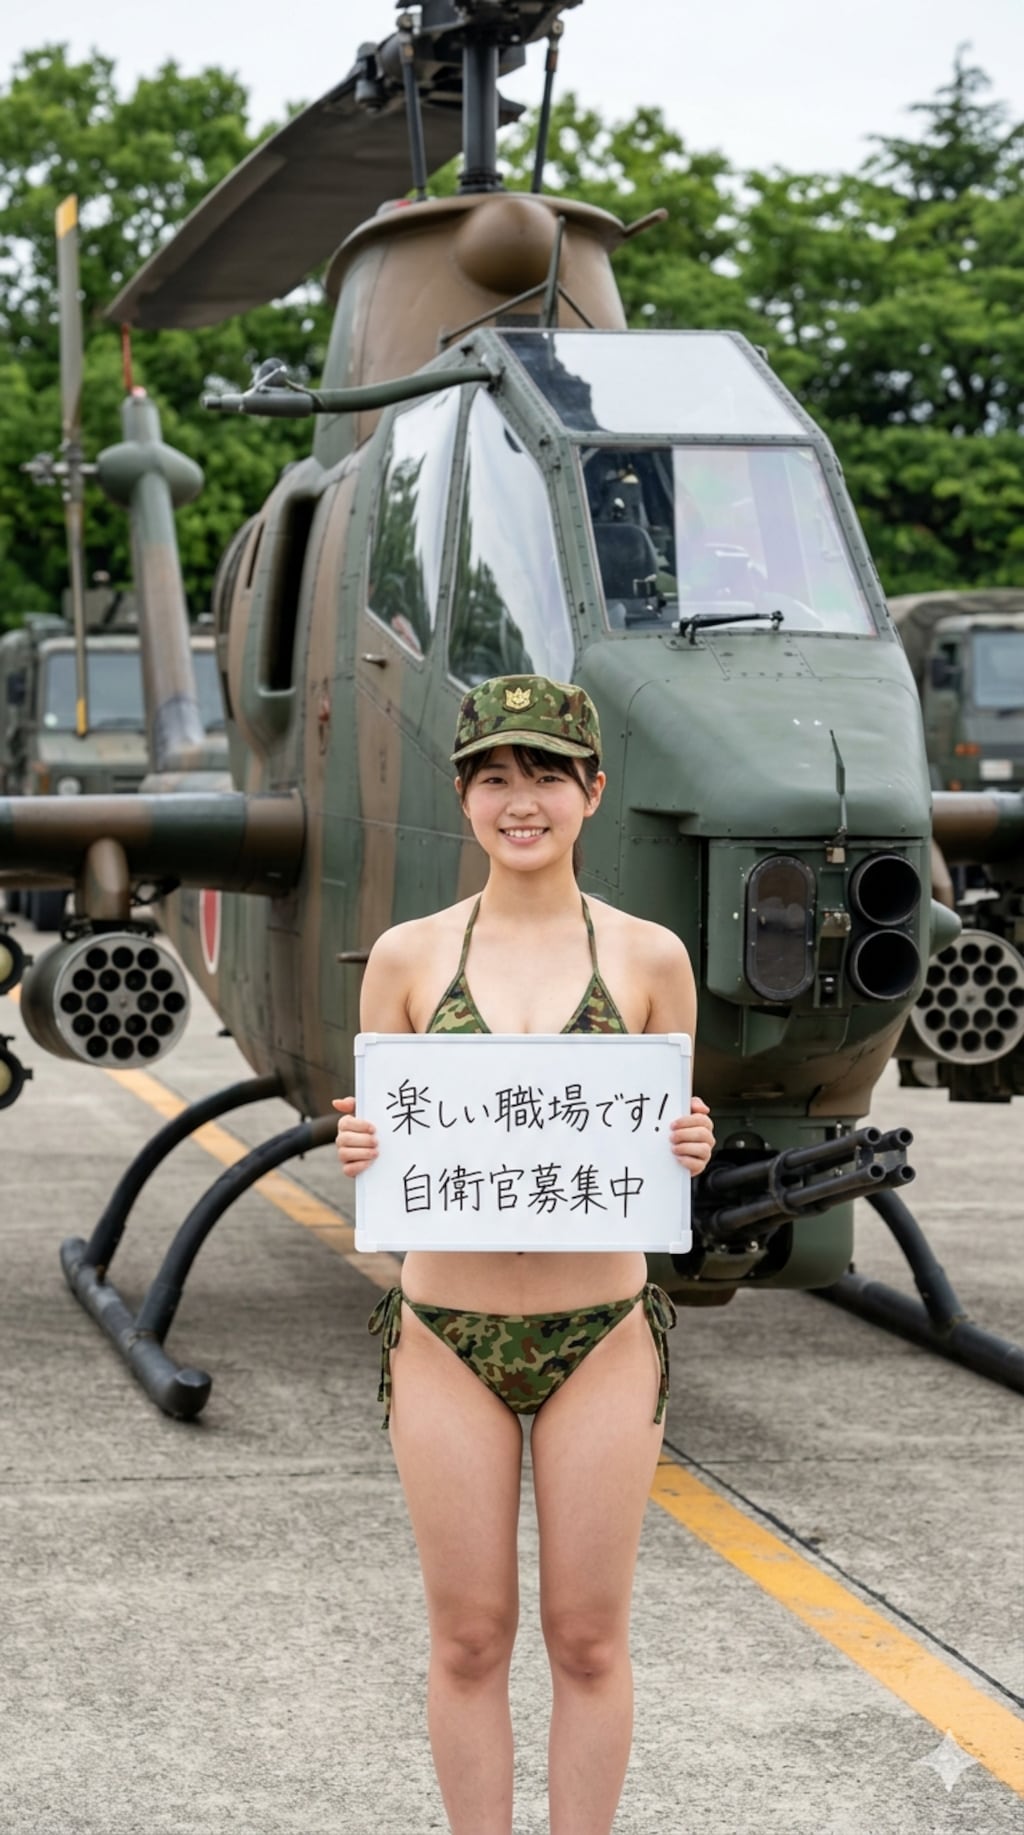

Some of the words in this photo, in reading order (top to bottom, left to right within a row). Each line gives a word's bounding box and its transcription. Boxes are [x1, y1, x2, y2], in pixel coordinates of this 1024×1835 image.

[386, 1078, 669, 1135] 楽しい職場です!
[402, 1162, 644, 1218] 自衛官募集中
